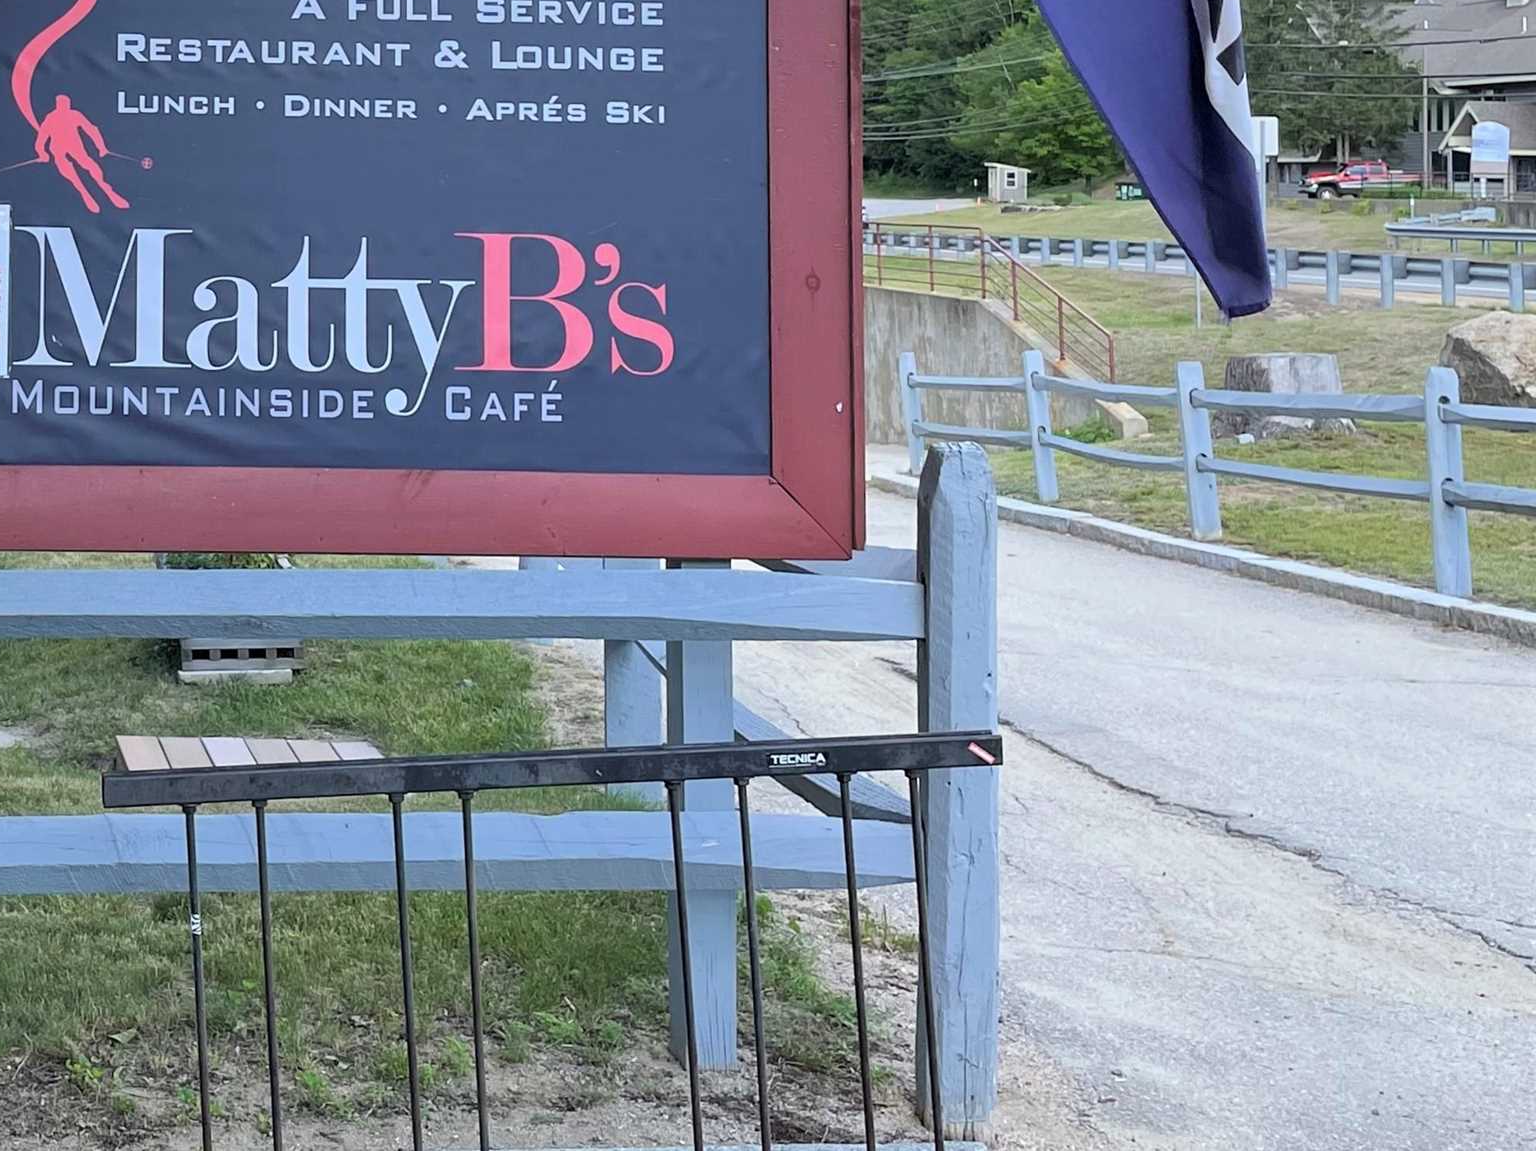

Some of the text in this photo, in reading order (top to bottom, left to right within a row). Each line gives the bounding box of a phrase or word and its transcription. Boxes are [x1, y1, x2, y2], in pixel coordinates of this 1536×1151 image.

[117, 33, 664, 72] RESTAURANT & LOUNGE
[117, 91, 235, 115] LUNCH
[284, 94, 417, 118] DINNER
[606, 101, 665, 124] SKI
[12, 379, 563, 422] MOUNTAINSIDE CAFÉ
[769, 752, 826, 765] TECNICA
